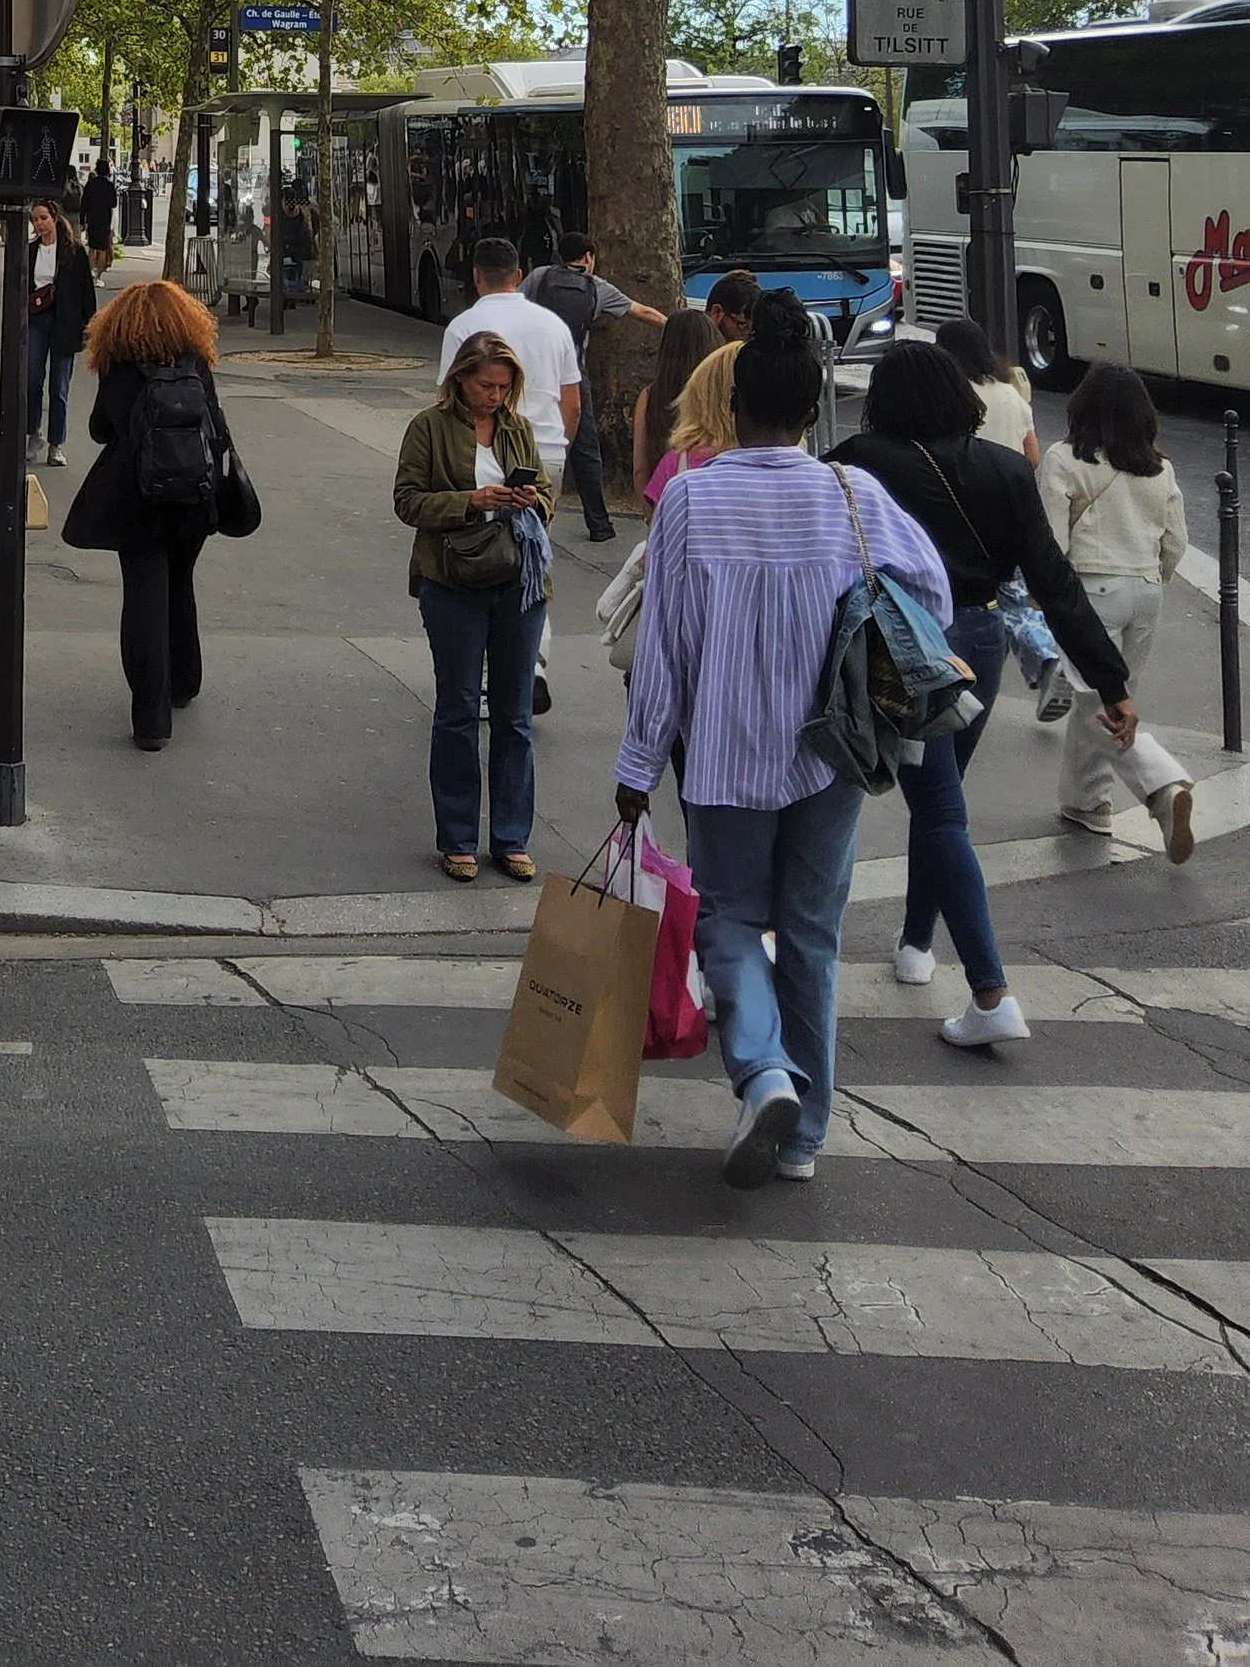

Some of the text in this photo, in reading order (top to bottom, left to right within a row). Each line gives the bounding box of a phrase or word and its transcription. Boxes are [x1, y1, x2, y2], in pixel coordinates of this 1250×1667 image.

[246, 9, 260, 18] Ch.
[261, 9, 272, 18] de
[274, 10, 300, 19] Gaulle
[897, 7, 924, 19] RUE
[272, 20, 307, 30] Wagram
[903, 23, 918, 33] DE
[212, 29, 226, 40] 30
[874, 37, 949, 54] TILSITT
[213, 52, 225, 62] 31
[529, 979, 583, 1016] QUATORZE
